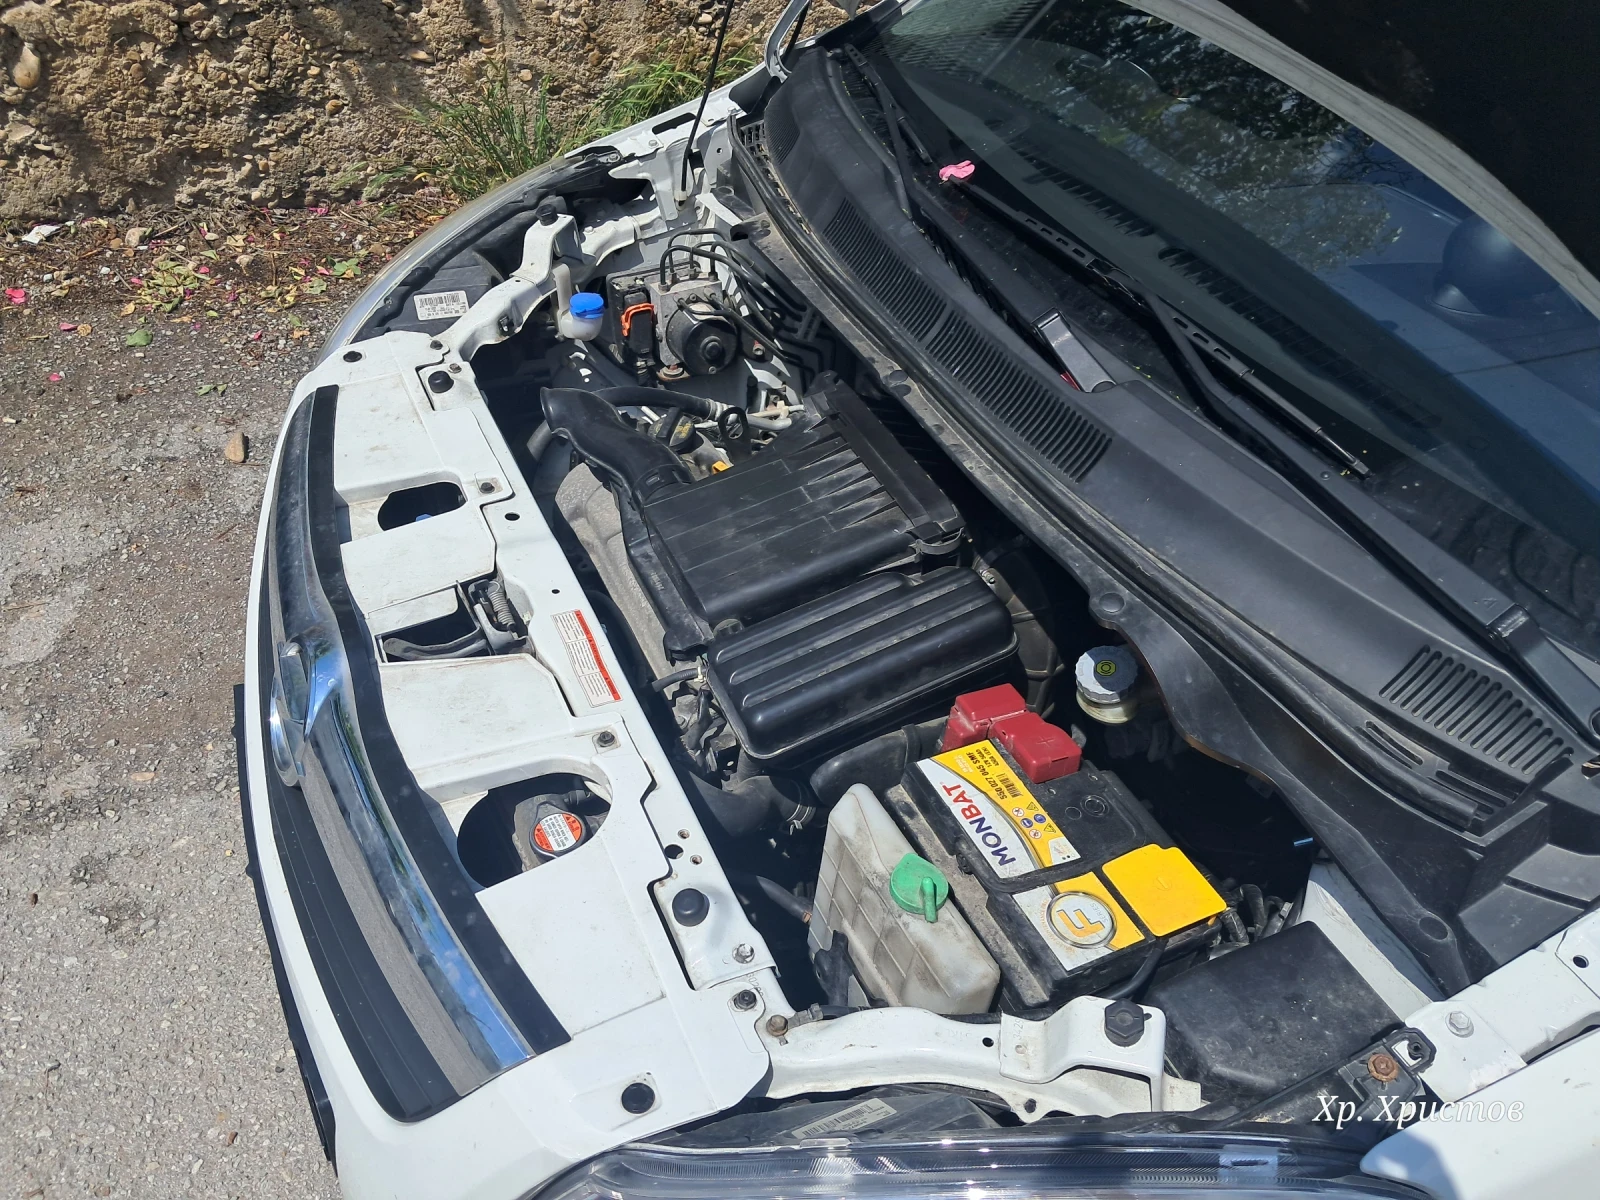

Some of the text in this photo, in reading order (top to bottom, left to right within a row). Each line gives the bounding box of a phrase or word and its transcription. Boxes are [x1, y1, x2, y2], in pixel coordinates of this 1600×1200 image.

[966, 752, 1008, 800] 550 027 045 SMF
[942, 783, 1016, 866] MONBAT
[1056, 908, 1106, 938] F
[1090, 902, 1108, 923] SERIES
